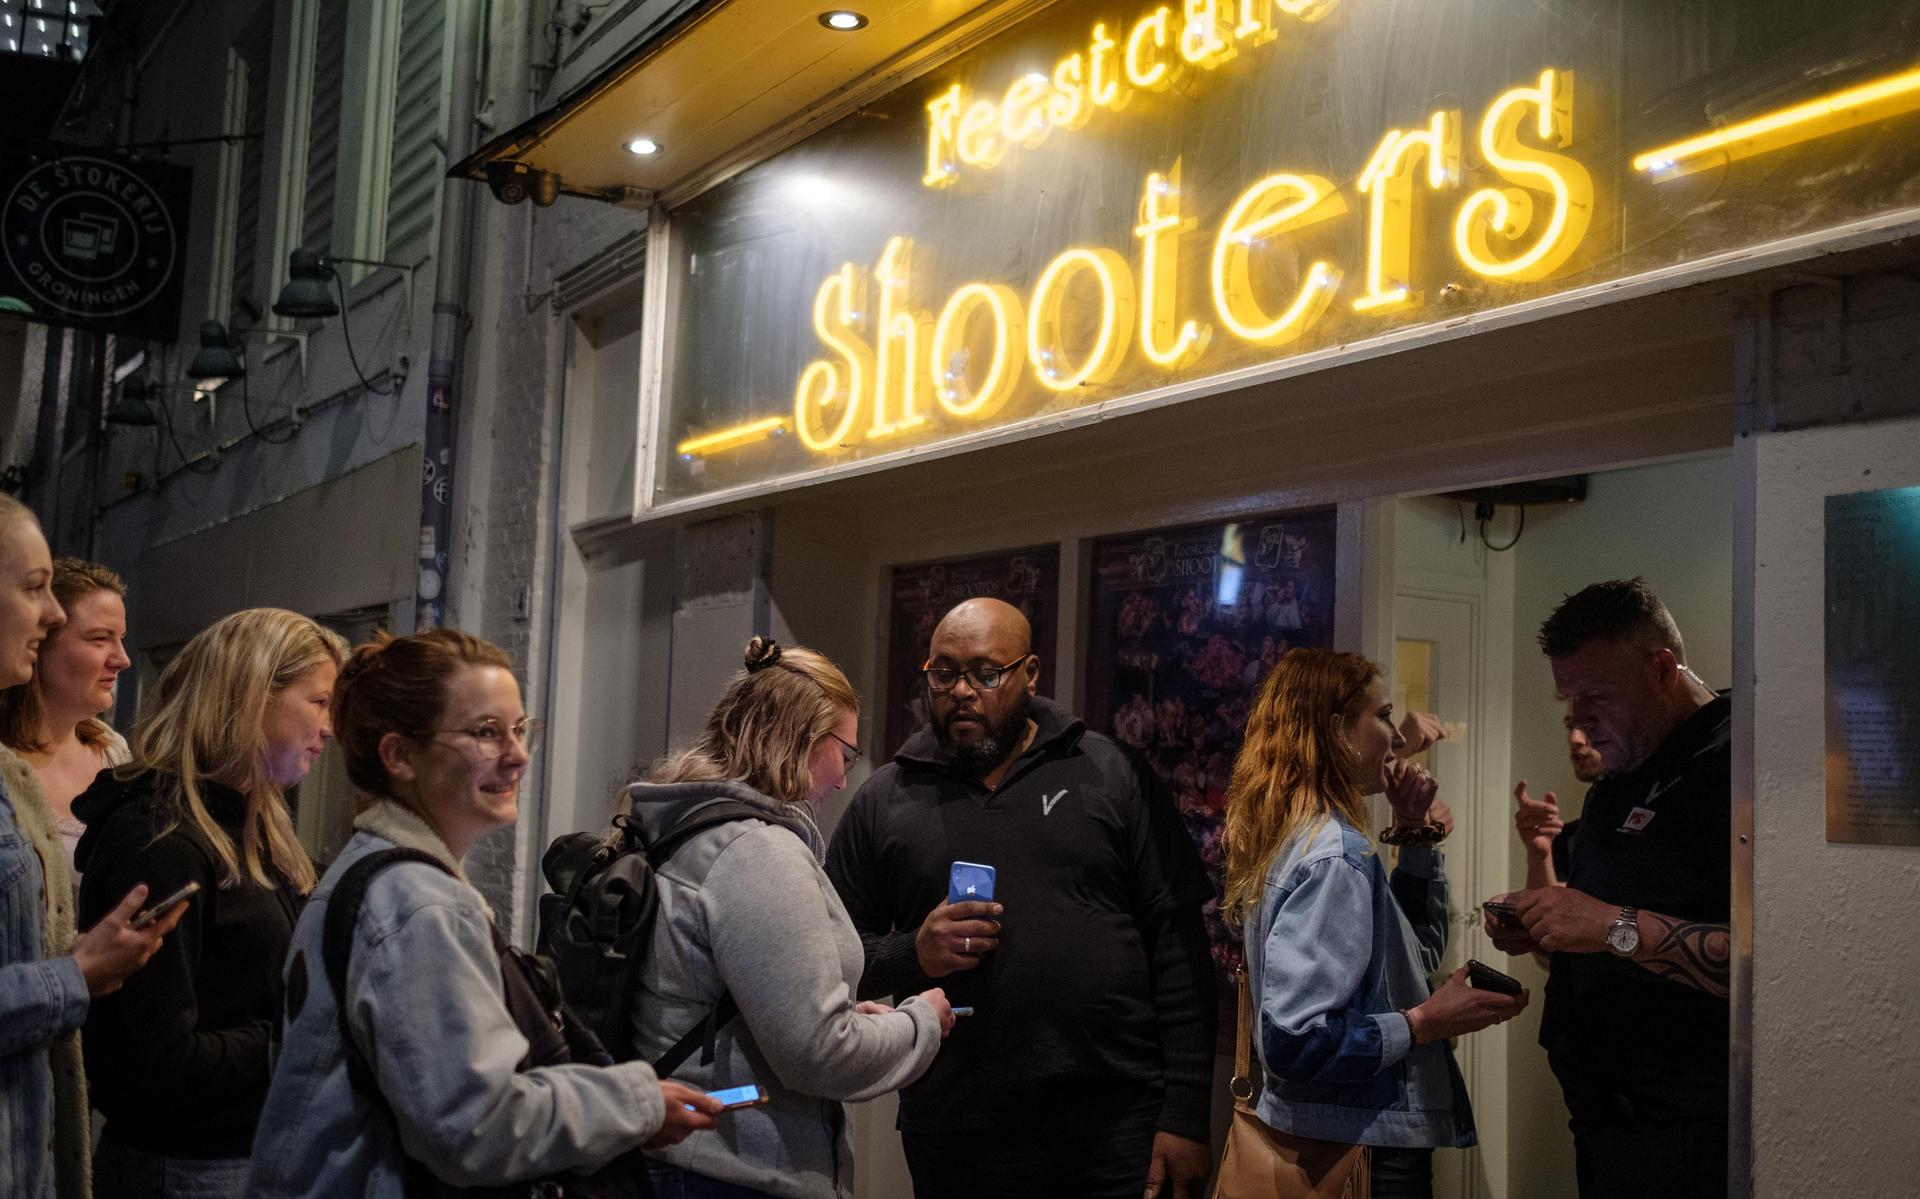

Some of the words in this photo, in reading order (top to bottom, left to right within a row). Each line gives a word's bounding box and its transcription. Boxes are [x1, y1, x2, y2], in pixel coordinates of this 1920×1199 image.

[16, 181, 50, 212] DE
[54, 165, 165, 234] STOKERIJ
[28, 262, 140, 305] GRONINGEN
[794, 68, 1594, 455] Shooters
